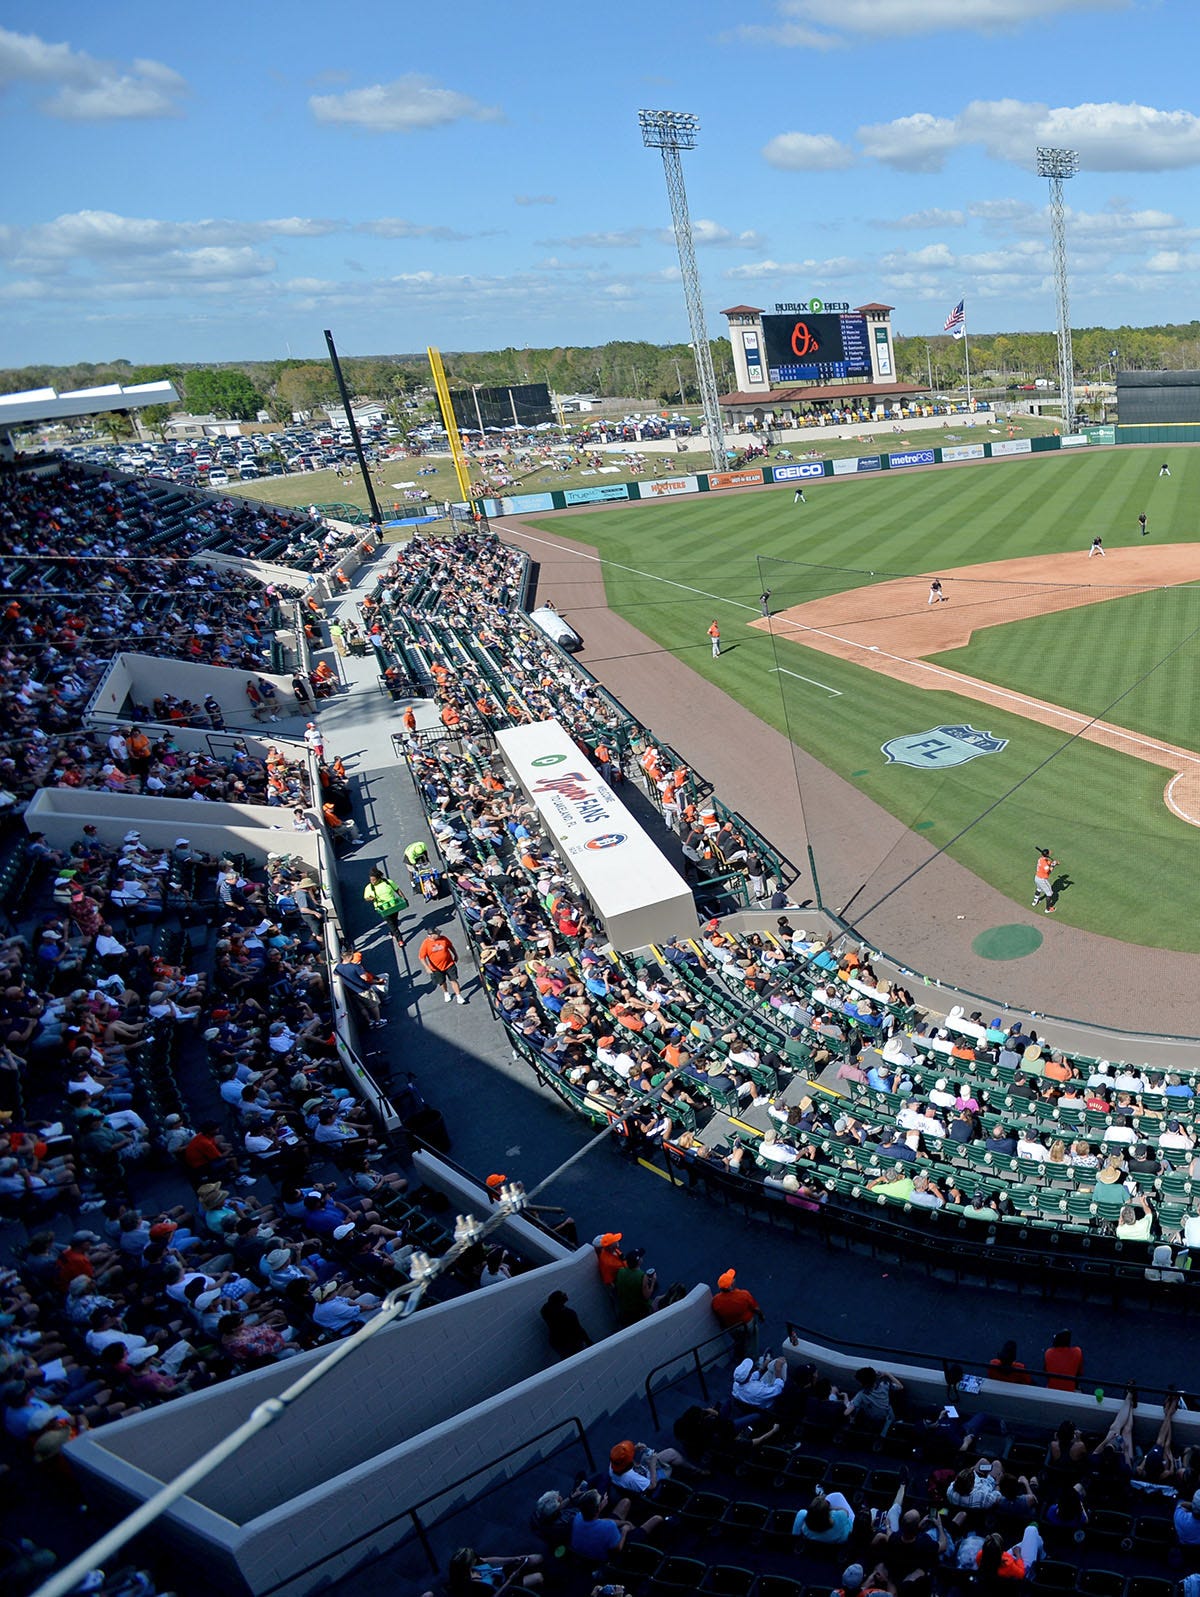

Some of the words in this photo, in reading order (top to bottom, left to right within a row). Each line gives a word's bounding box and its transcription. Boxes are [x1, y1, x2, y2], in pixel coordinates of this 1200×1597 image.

[775, 303, 808, 311] PUBLIX
[824, 302, 849, 310] FIELD
[891, 452, 933, 466] metroPCS
[776, 464, 822, 480] GEICO
[651, 481, 687, 492] HOOTERS
[906, 738, 952, 760] FL
[532, 772, 596, 801] Tigers
[574, 798, 610, 824] FANS
[596, 784, 616, 804] WELCOME
